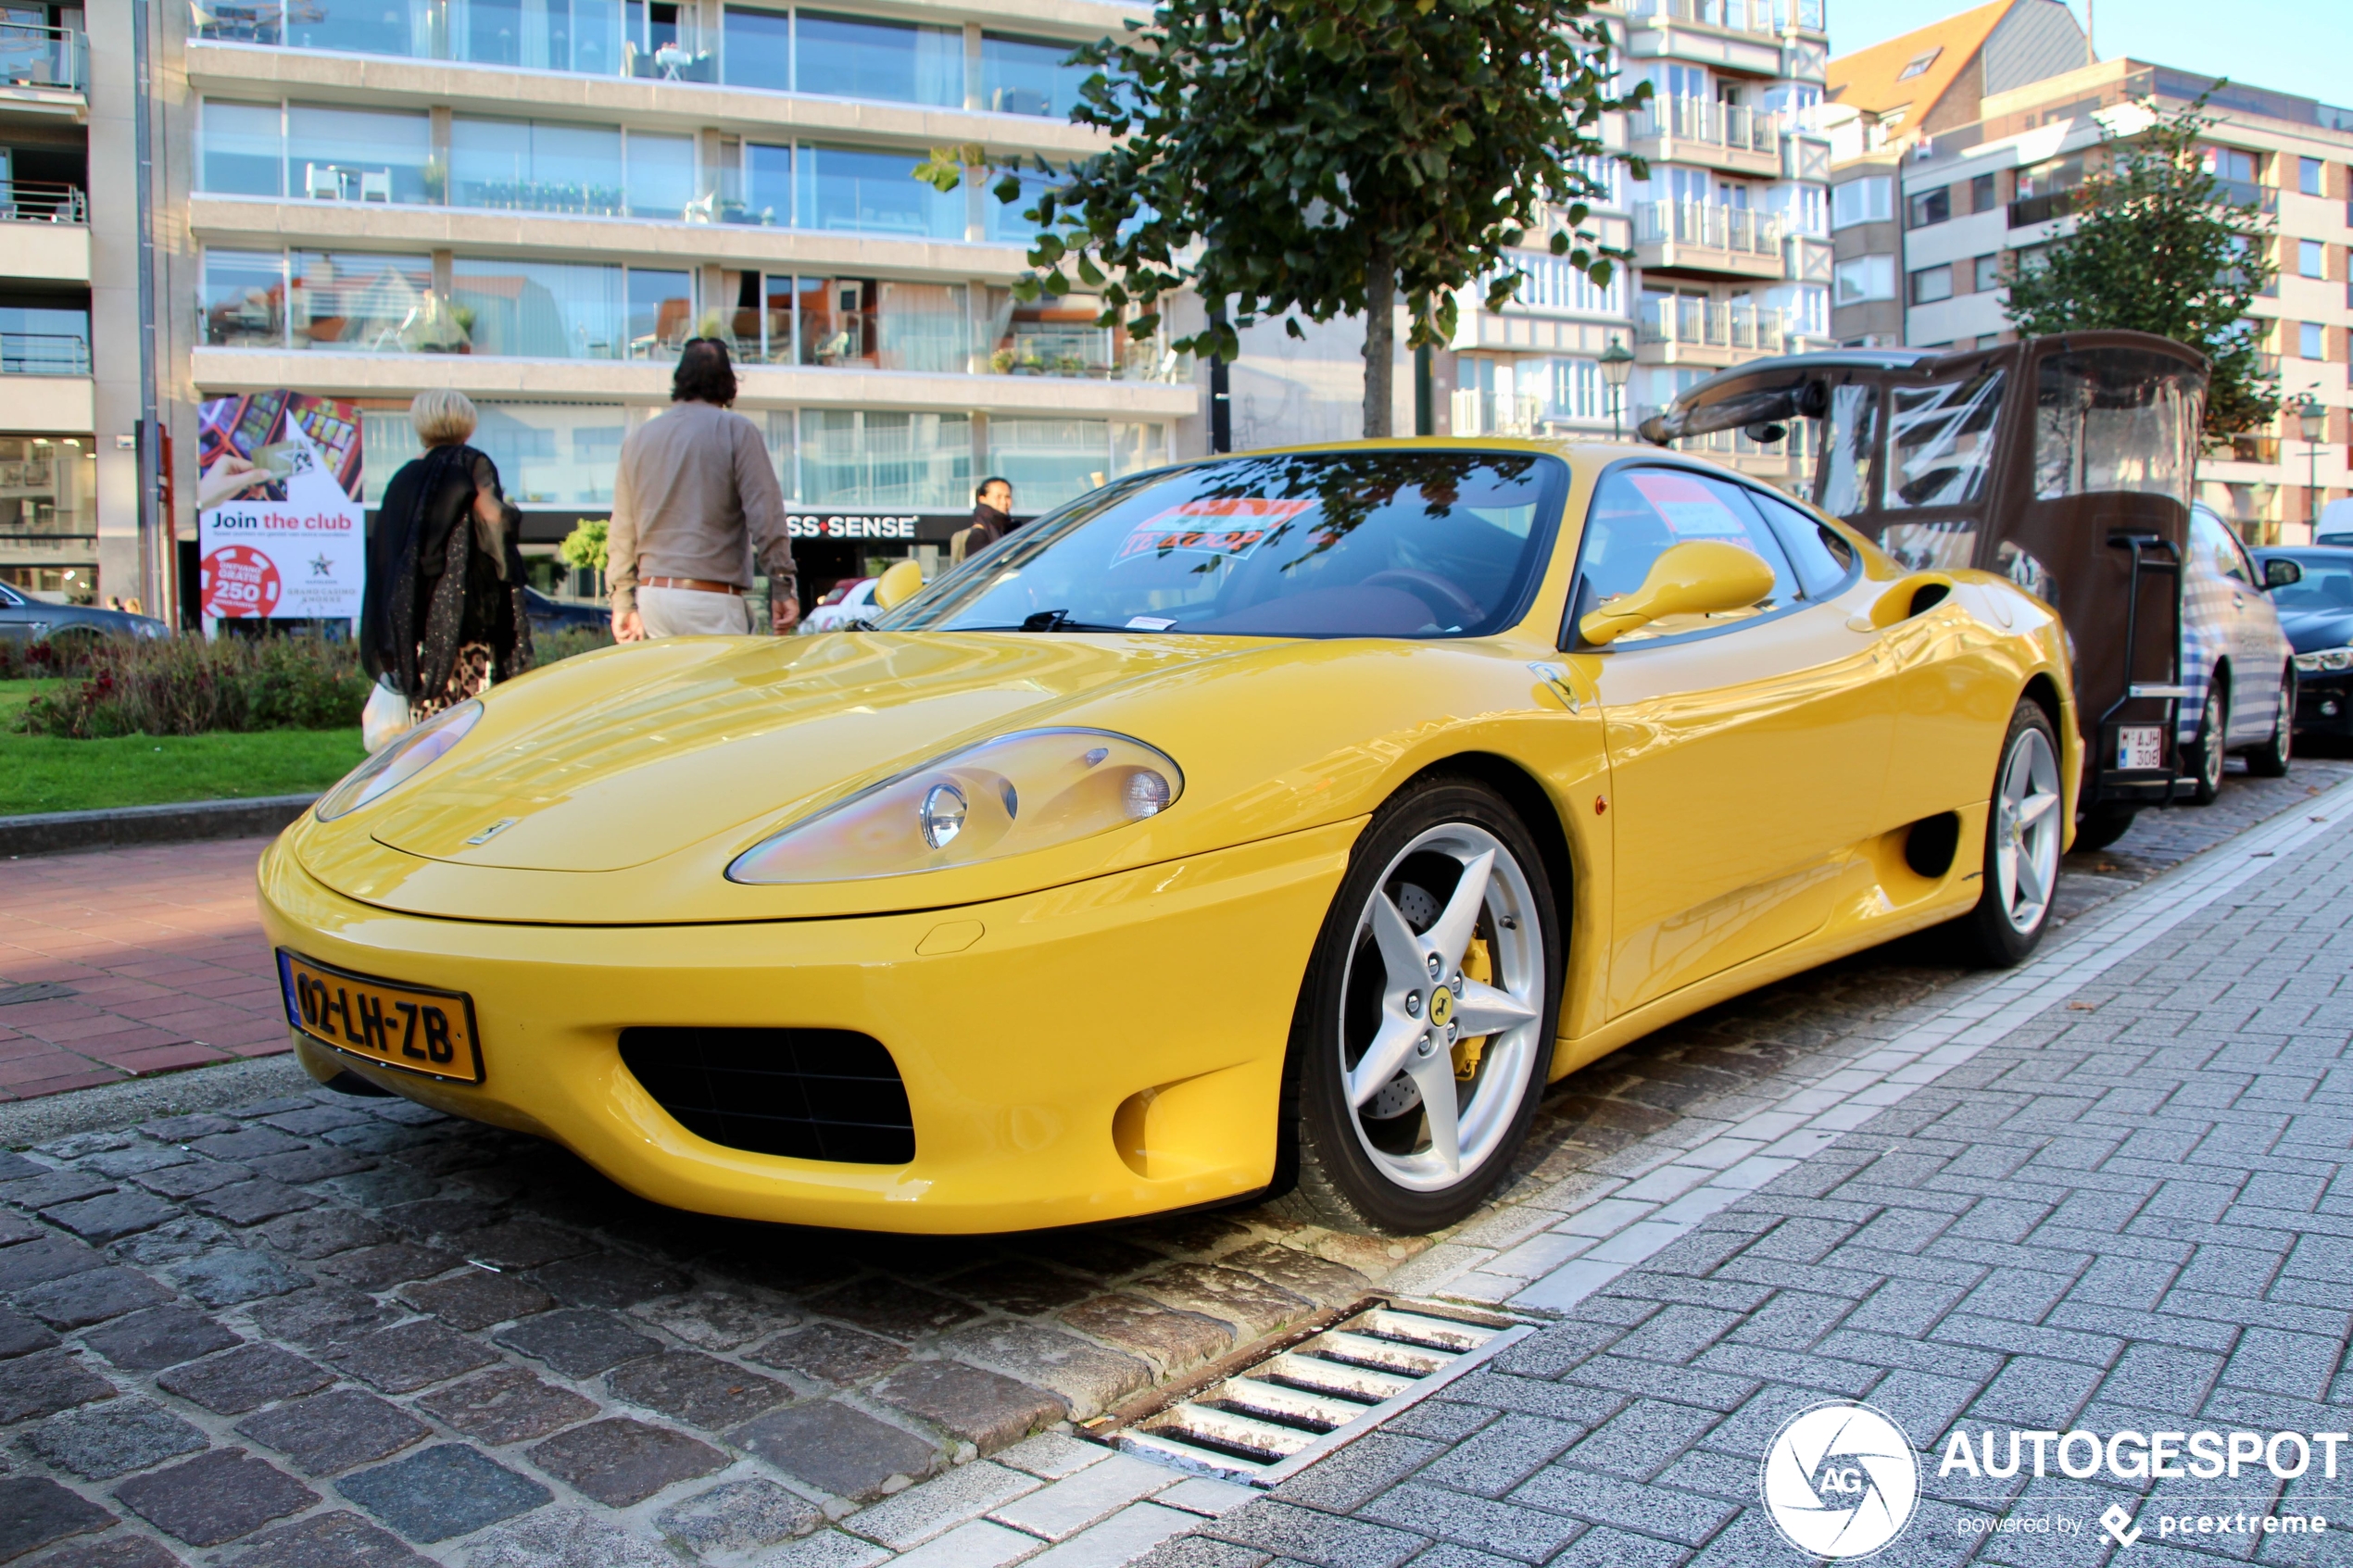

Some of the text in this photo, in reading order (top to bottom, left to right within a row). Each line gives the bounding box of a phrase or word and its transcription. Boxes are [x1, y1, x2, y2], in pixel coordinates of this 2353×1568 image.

[212, 511, 352, 530] Join the club
[1120, 530, 1264, 558] TE KOOP
[218, 568, 262, 584] GRATIS
[214, 579, 261, 603] 250
[287, 587, 357, 596] GRAND CASINO
[297, 972, 454, 1064] 02-LH-ZB
